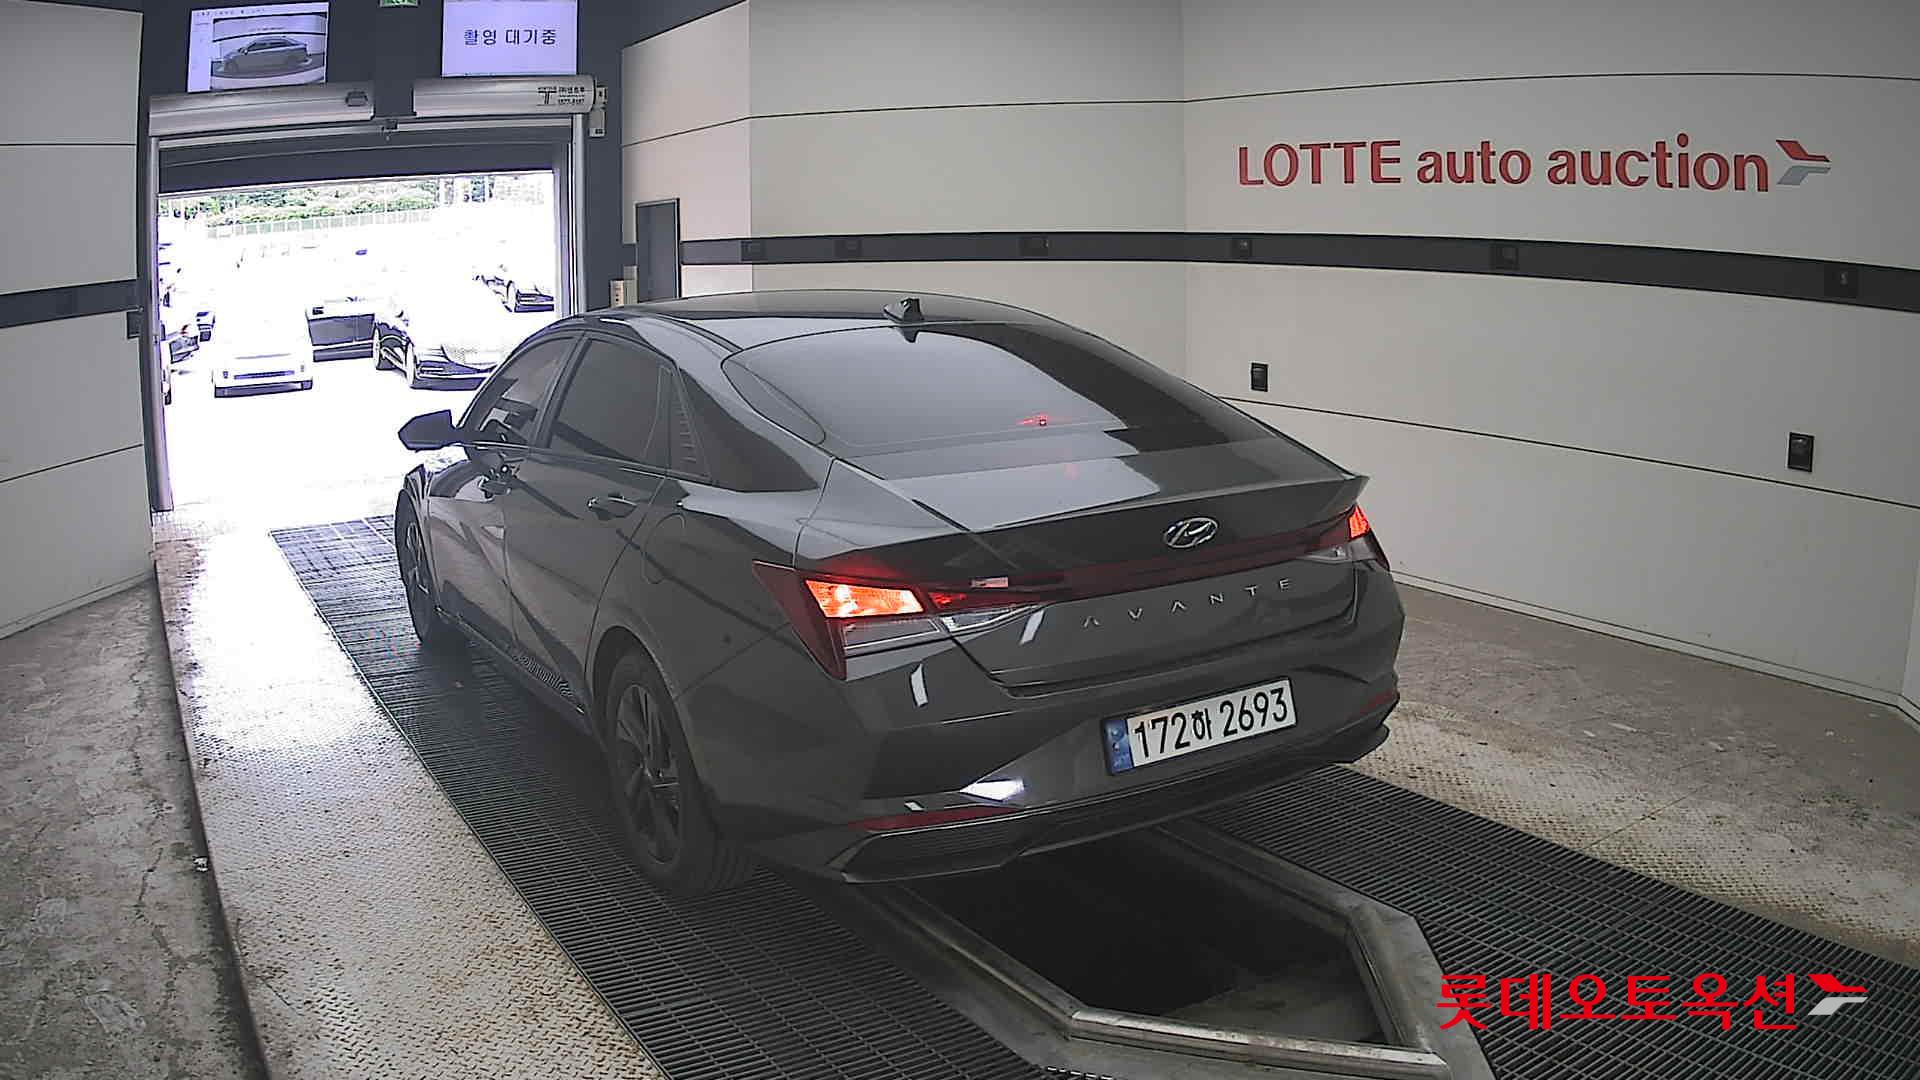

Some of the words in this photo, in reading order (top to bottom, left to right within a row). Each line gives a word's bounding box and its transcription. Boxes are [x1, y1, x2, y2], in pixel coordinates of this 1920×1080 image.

[464, 29, 497, 46] 촬영
[505, 29, 557, 46] 대기중
[1239, 140, 1401, 187] LOTTE
[1416, 140, 1532, 185] auto
[1547, 133, 1769, 192] auction
[1083, 579, 1290, 628] AVANTE
[1134, 708, 1213, 758] 172하
[1219, 687, 1288, 738] 2693
